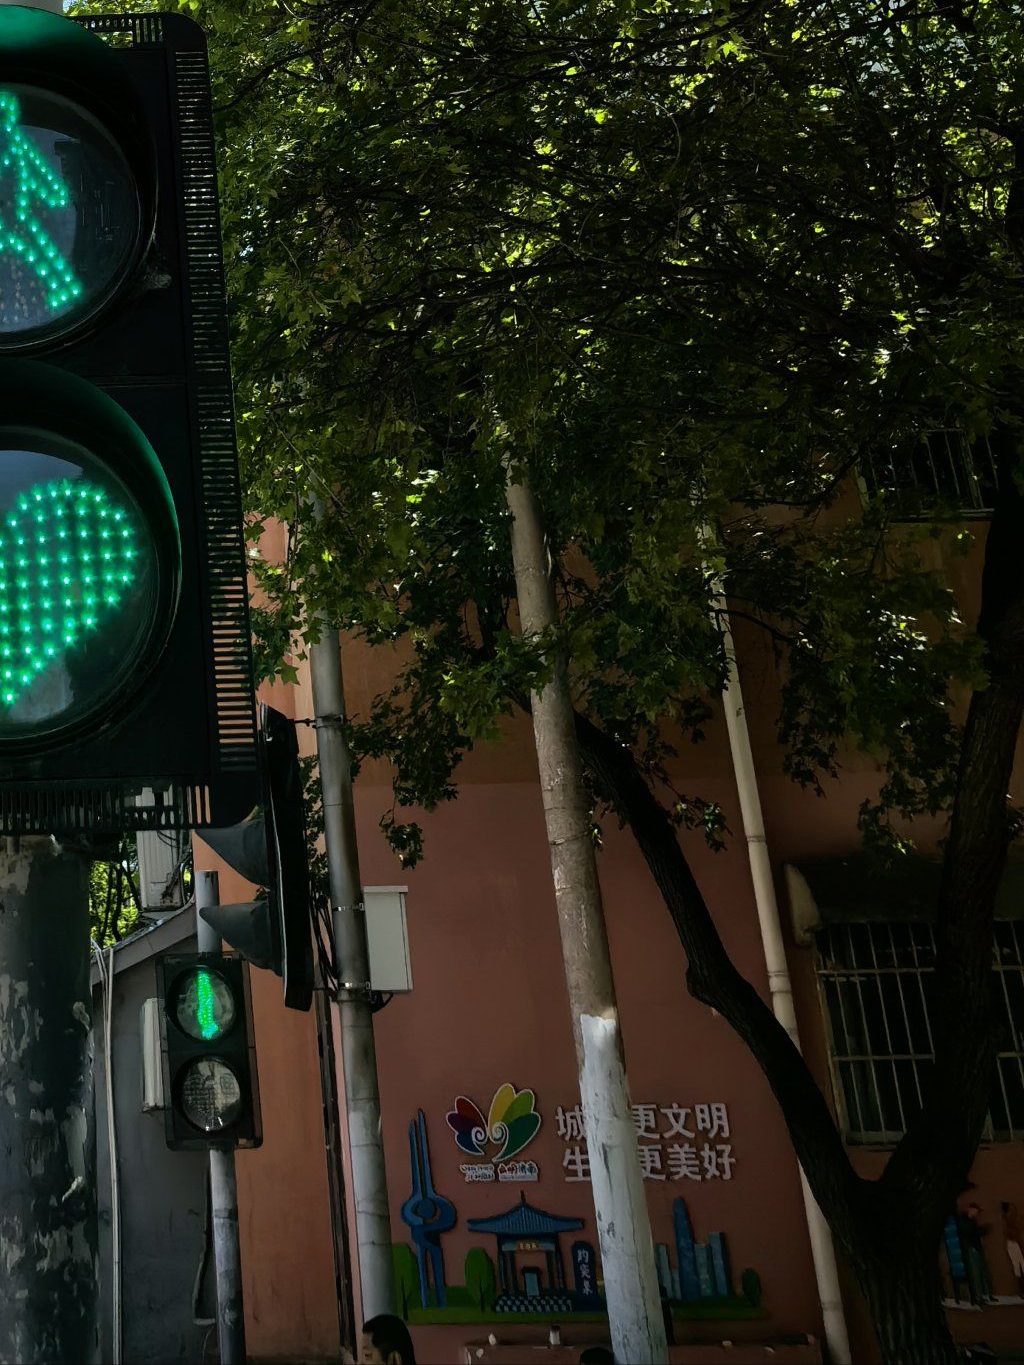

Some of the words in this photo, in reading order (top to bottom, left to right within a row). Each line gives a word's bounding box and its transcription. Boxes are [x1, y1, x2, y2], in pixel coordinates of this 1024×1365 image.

[555, 1102, 730, 1141] 城更文明
[563, 1144, 736, 1182] 生更美好
